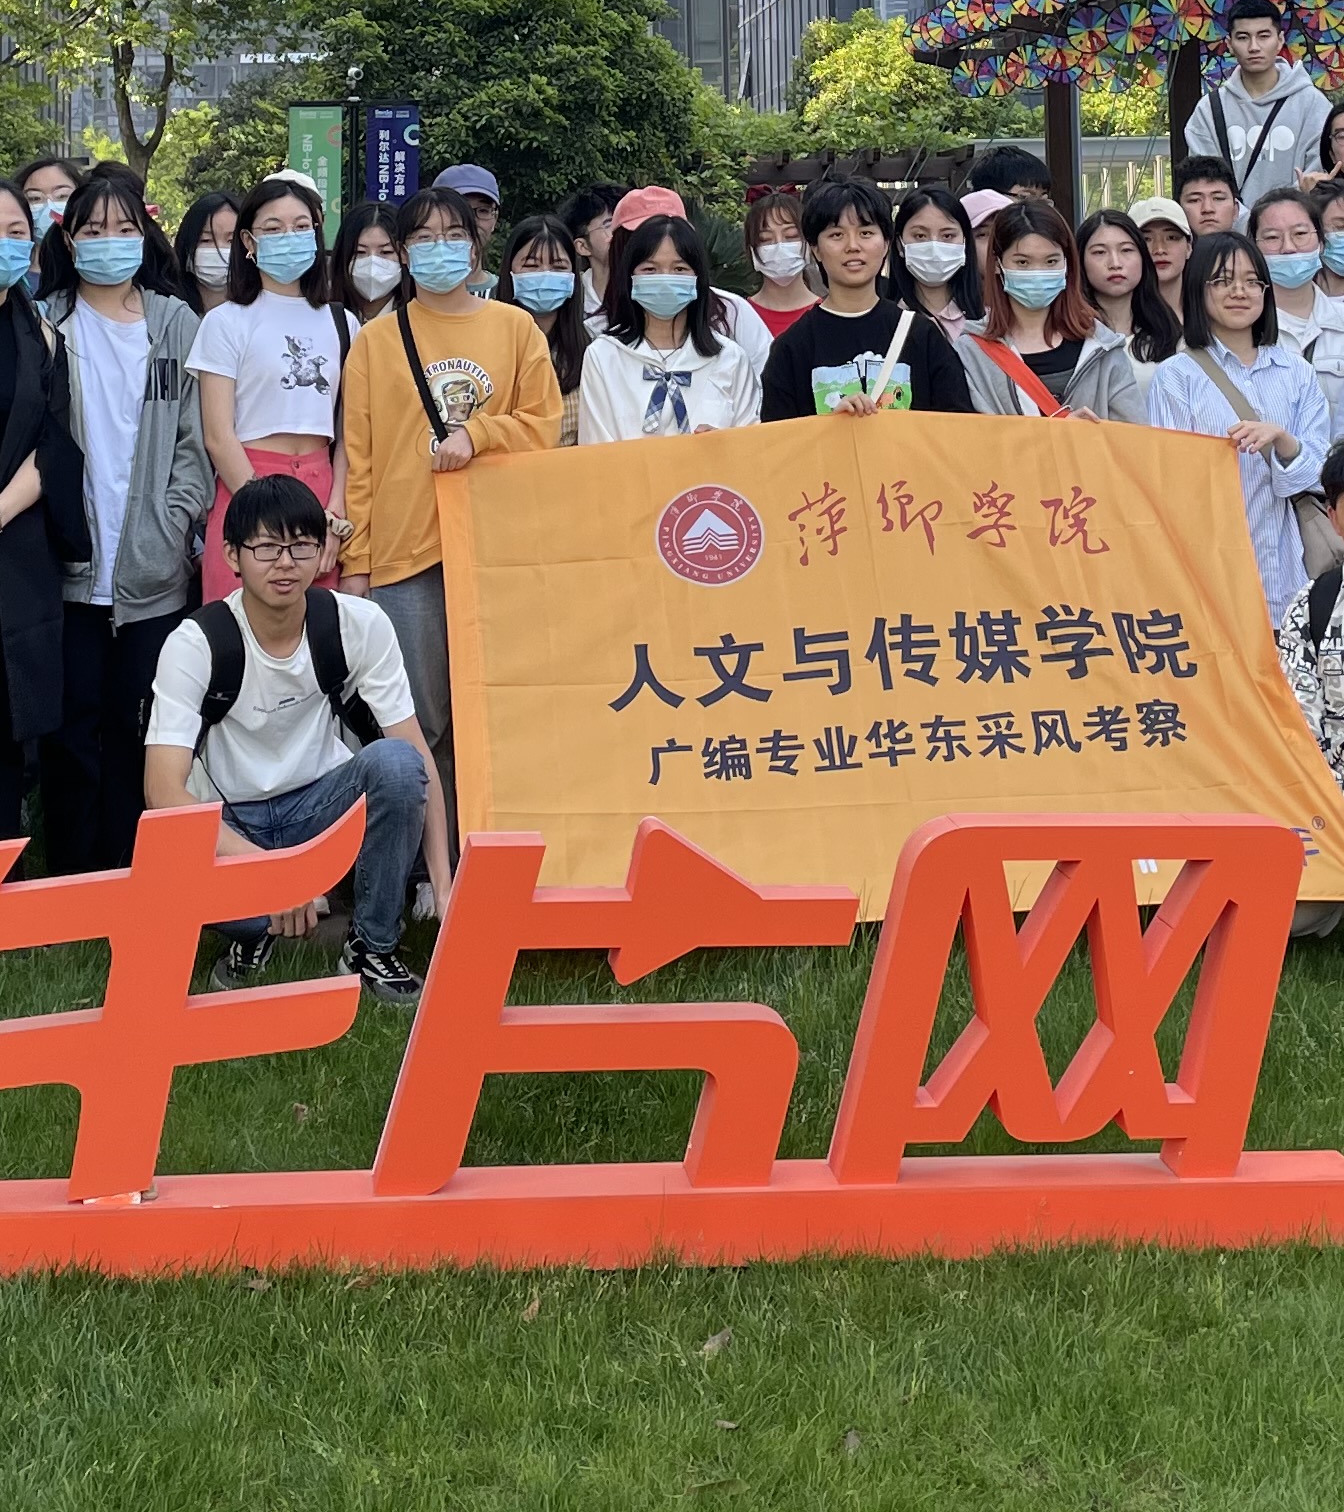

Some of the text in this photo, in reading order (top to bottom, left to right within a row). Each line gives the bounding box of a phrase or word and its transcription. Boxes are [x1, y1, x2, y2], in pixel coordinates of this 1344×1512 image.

[394, 150, 406, 196] 解决方案
[424, 359, 493, 394] TRONAUTICS
[609, 603, 1199, 712] 人文与传媒学院
[648, 697, 1187, 786] 广编专业华东采风考察
